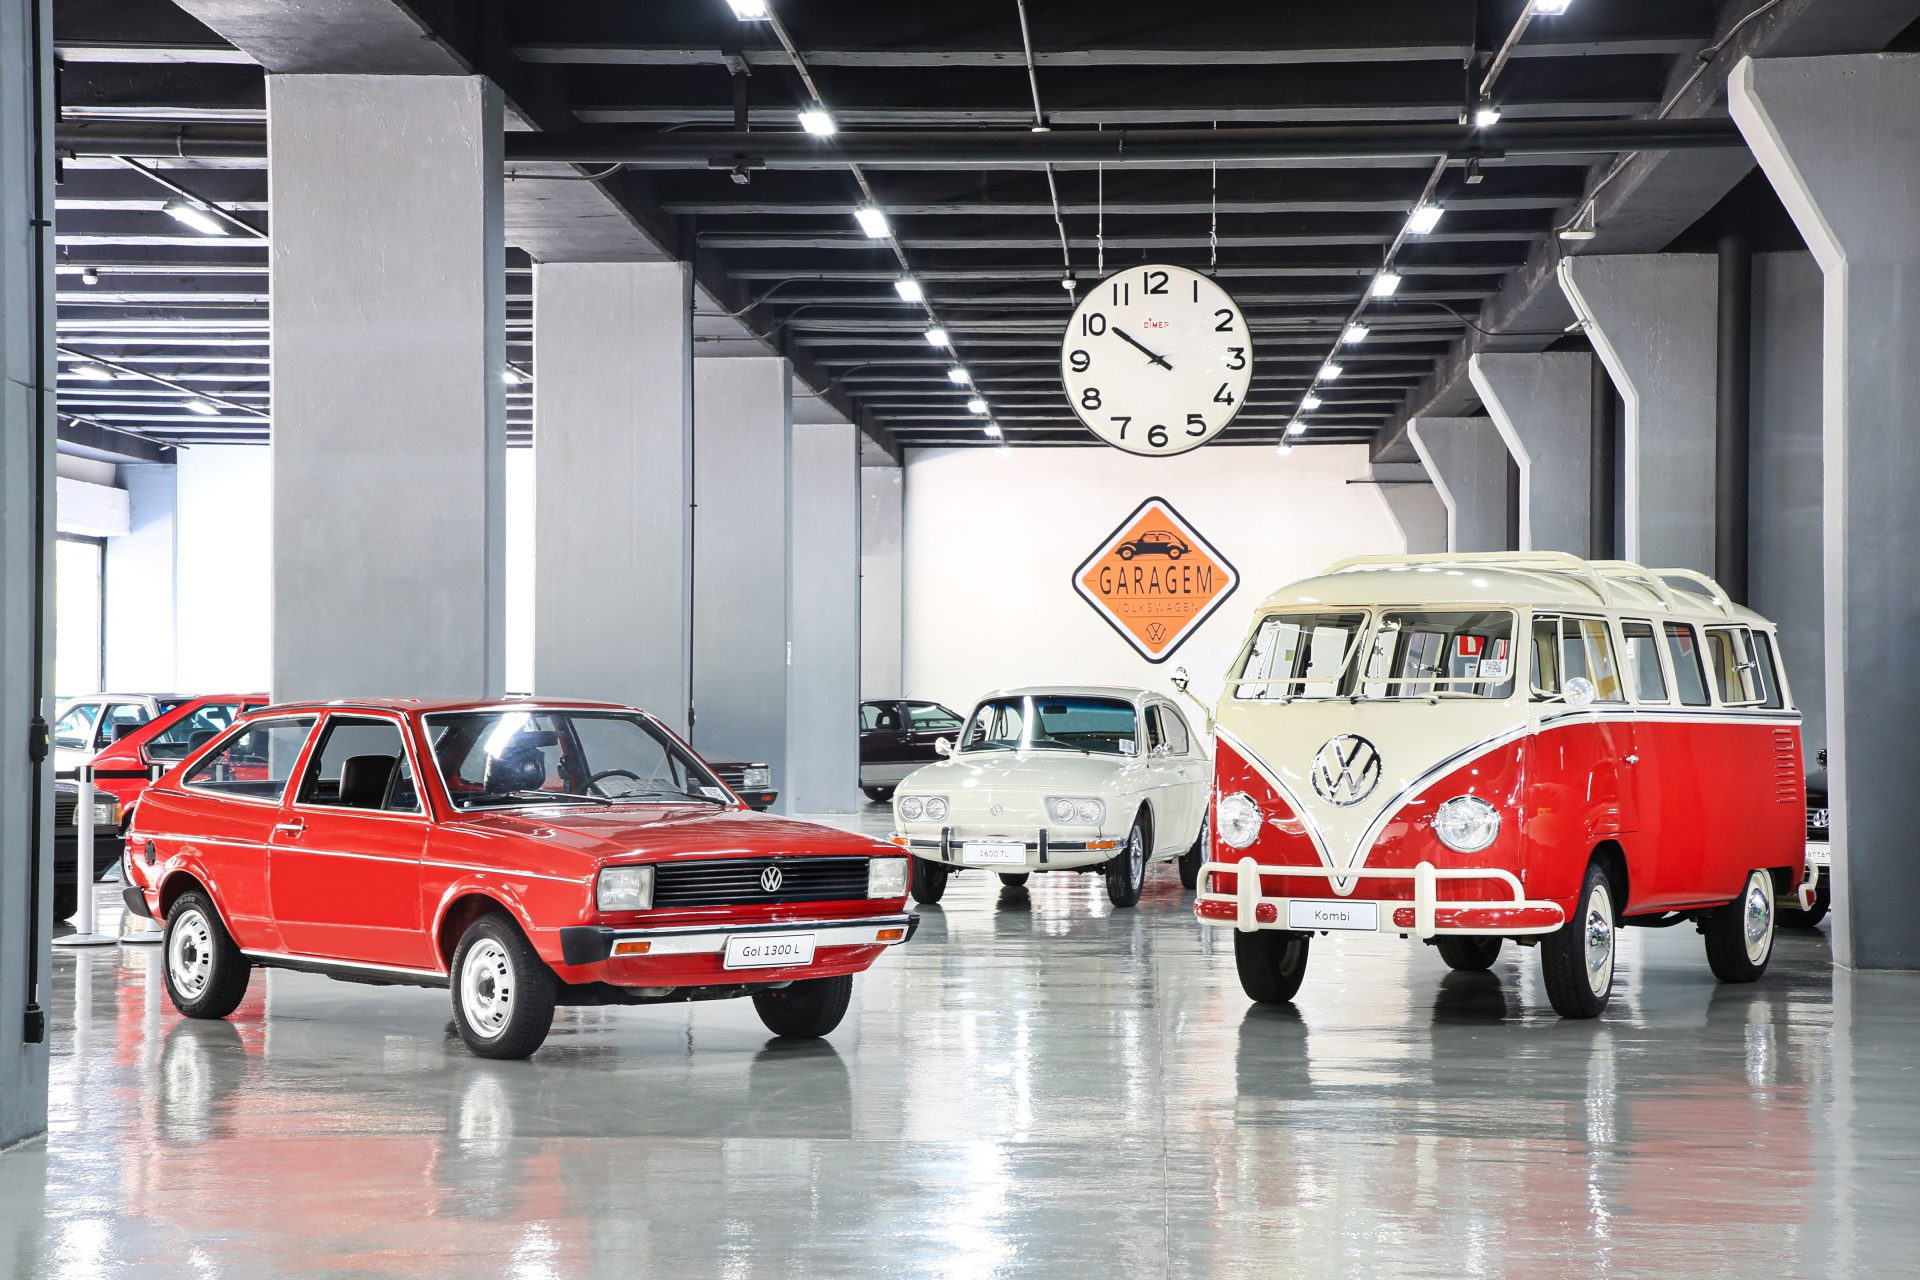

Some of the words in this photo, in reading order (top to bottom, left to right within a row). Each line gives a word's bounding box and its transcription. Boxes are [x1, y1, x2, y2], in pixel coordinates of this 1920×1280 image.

[1113, 283, 1129, 306] 11
[1144, 271, 1169, 295] 12
[1193, 280, 1198, 303] 1
[1082, 312, 1107, 336] 10
[1214, 308, 1234, 332] 2
[1069, 349, 1091, 373] 9
[1226, 347, 1246, 370] 3
[1081, 387, 1102, 410] 8
[1213, 382, 1235, 406] 4
[1110, 416, 1132, 440] 7
[1147, 424, 1169, 448] 6
[1185, 413, 1207, 437] 5
[1099, 565, 1212, 595] GARAGEM
[1114, 602, 1198, 613] VOLKSWAGEN
[1312, 734, 1381, 807] VW
[979, 850, 999, 858] 1600
[1000, 850, 1010, 858] TL
[761, 866, 782, 892] VW
[1314, 910, 1350, 921] Kombi
[742, 945, 761, 957] Gol
[764, 944, 792, 956] 1300
[794, 943, 800, 954] L
